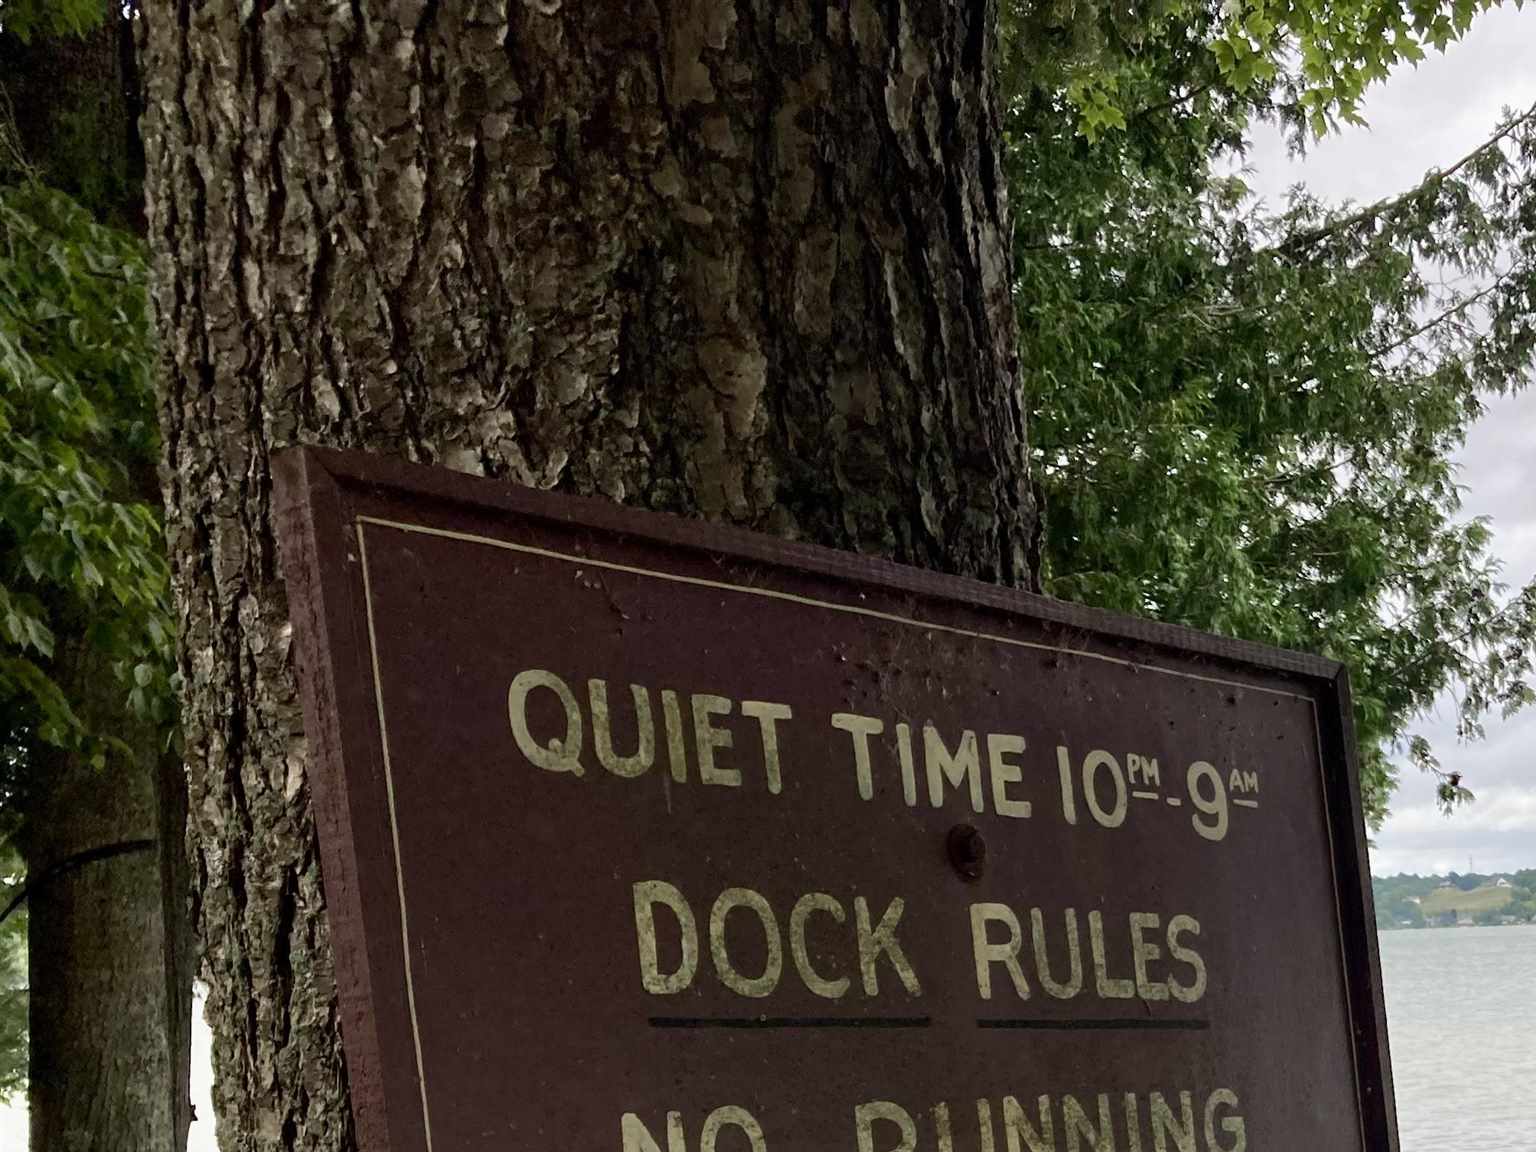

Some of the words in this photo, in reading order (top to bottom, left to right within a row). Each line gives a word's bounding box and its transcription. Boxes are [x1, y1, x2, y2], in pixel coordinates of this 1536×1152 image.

[508, 668, 793, 796] QUIET
[831, 711, 1033, 819] TIME
[632, 878, 924, 1000] DOCK
[968, 901, 1208, 1005] RULES
